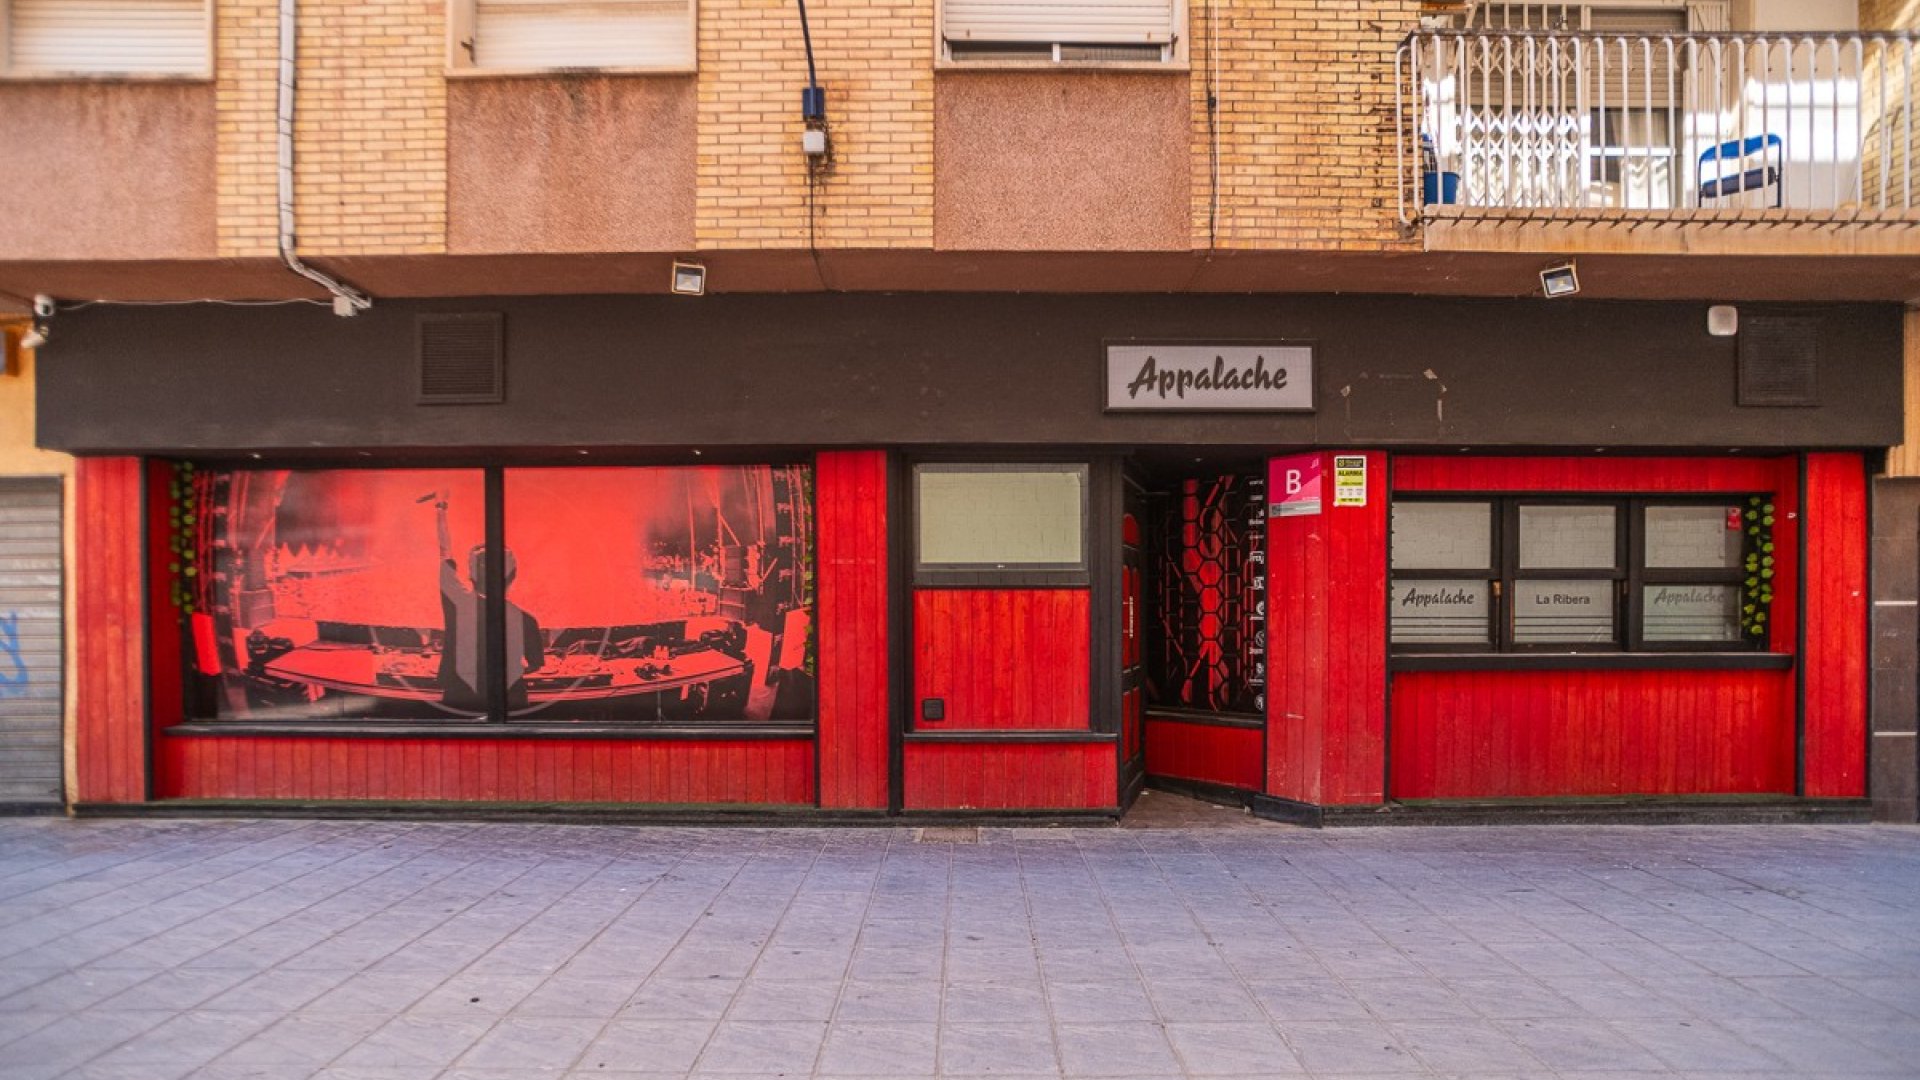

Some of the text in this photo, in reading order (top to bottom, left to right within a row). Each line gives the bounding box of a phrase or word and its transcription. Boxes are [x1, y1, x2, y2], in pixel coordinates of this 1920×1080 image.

[1127, 355, 1288, 399] Appalache
[1286, 469, 1302, 495] B
[1402, 588, 1475, 607] Appalache
[1536, 594, 1590, 605] La Ribera
[1654, 588, 1725, 605] Appalache
